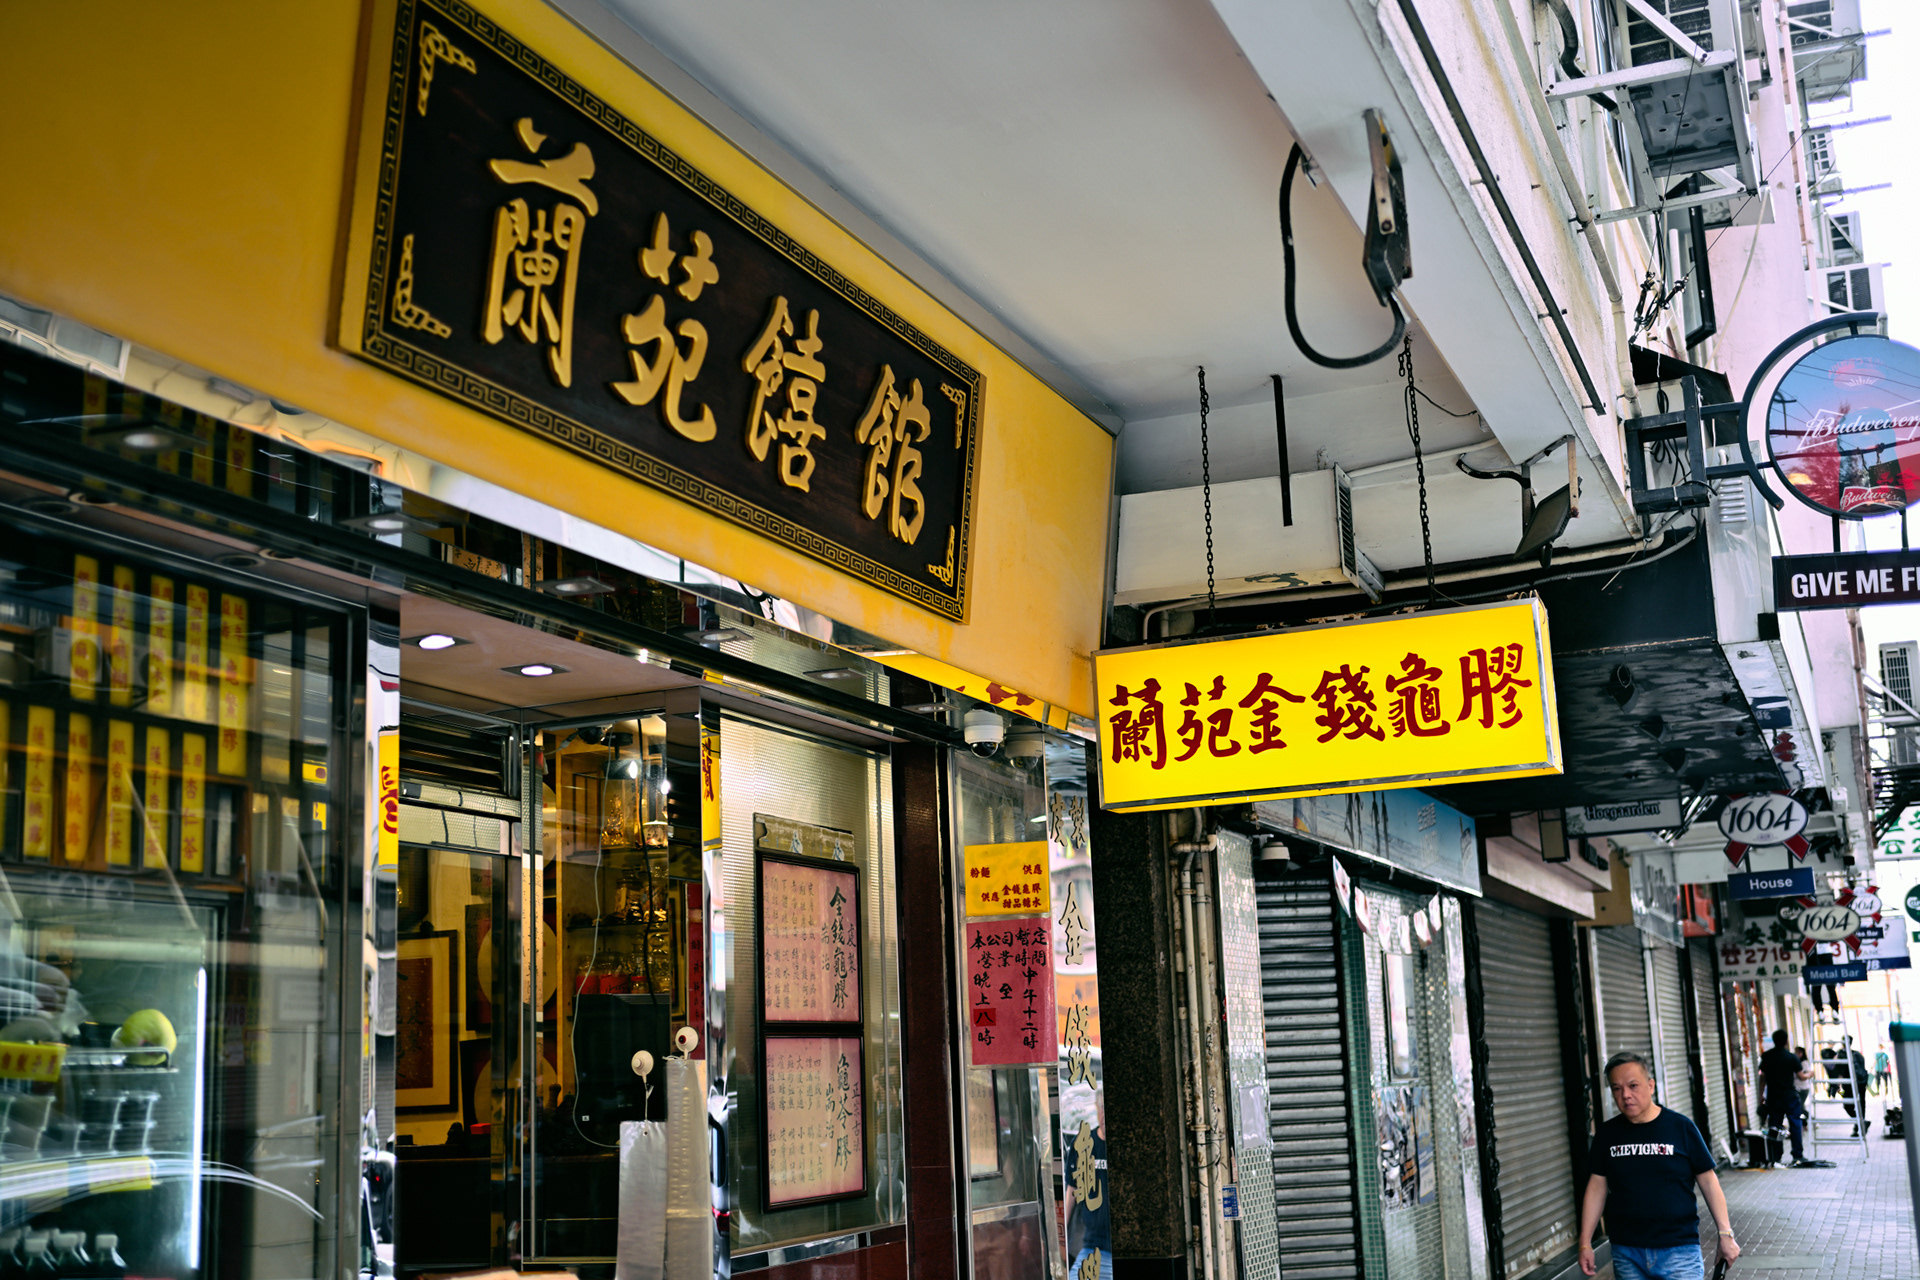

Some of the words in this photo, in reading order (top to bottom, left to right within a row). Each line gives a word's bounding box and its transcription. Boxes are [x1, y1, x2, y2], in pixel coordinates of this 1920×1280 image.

[485, 117, 932, 546] 蘭苑饎館
[1840, 490, 1904, 510] Budweise
[1791, 571, 1849, 598] GIVE
[1856, 569, 1895, 594] ME
[1108, 642, 1533, 771] 蘭苑金錢龜膠
[1584, 801, 1660, 822] Hoegaarden
[1728, 795, 1799, 834] 1664
[1022, 863, 1043, 876] 供應
[1749, 876, 1793, 890] House
[981, 891, 1000, 903] 供應
[1803, 910, 1852, 932] 1664
[1810, 968, 1839, 980] Metal
[1841, 967, 1860, 979] Bar
[999, 983, 1013, 1000] 至
[973, 973, 996, 1047] 晚上八時
[1020, 966, 1039, 1050] 中午十二時
[1610, 1144, 1674, 1157] CHEVIGNON
